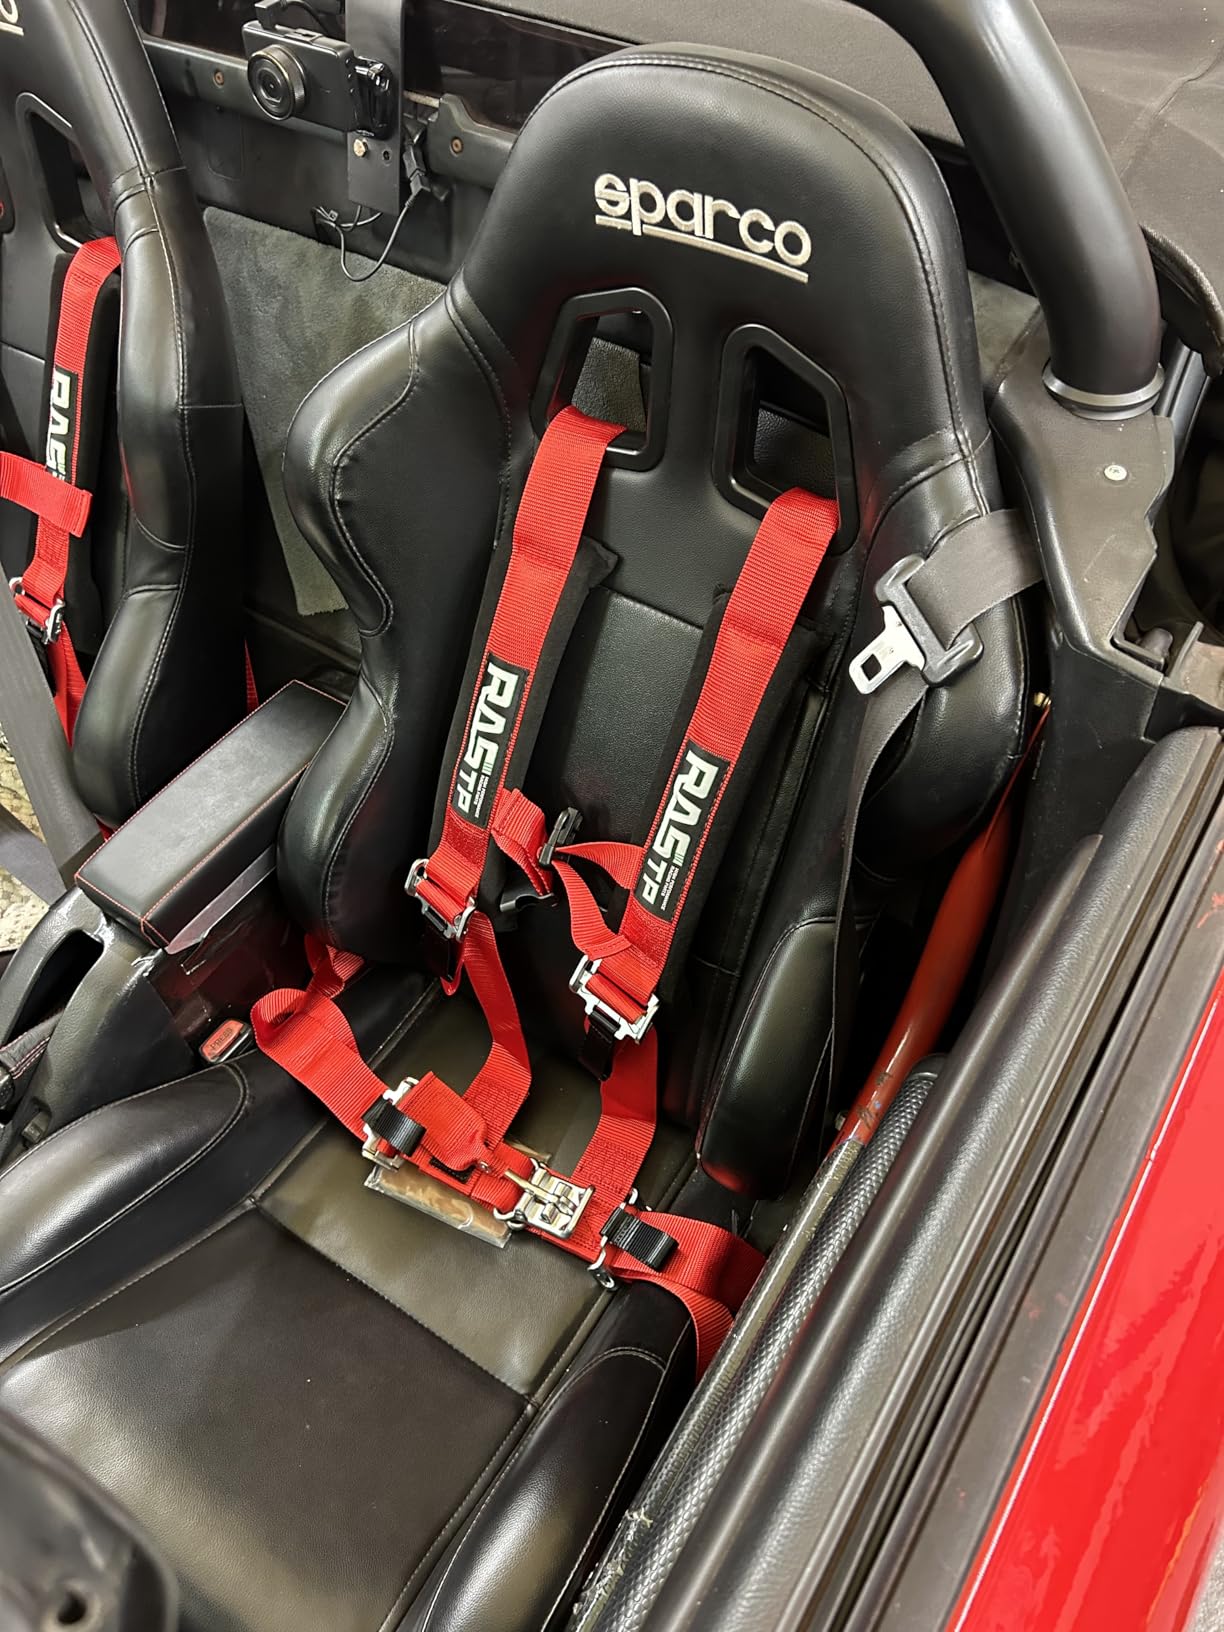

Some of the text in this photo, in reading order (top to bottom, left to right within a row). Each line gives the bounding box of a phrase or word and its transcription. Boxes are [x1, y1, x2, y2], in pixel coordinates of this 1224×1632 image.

[594, 173, 812, 267] sparco
[45, 368, 71, 477] RAS
[457, 662, 519, 814] RASTP
[642, 749, 719, 905] RASTP
